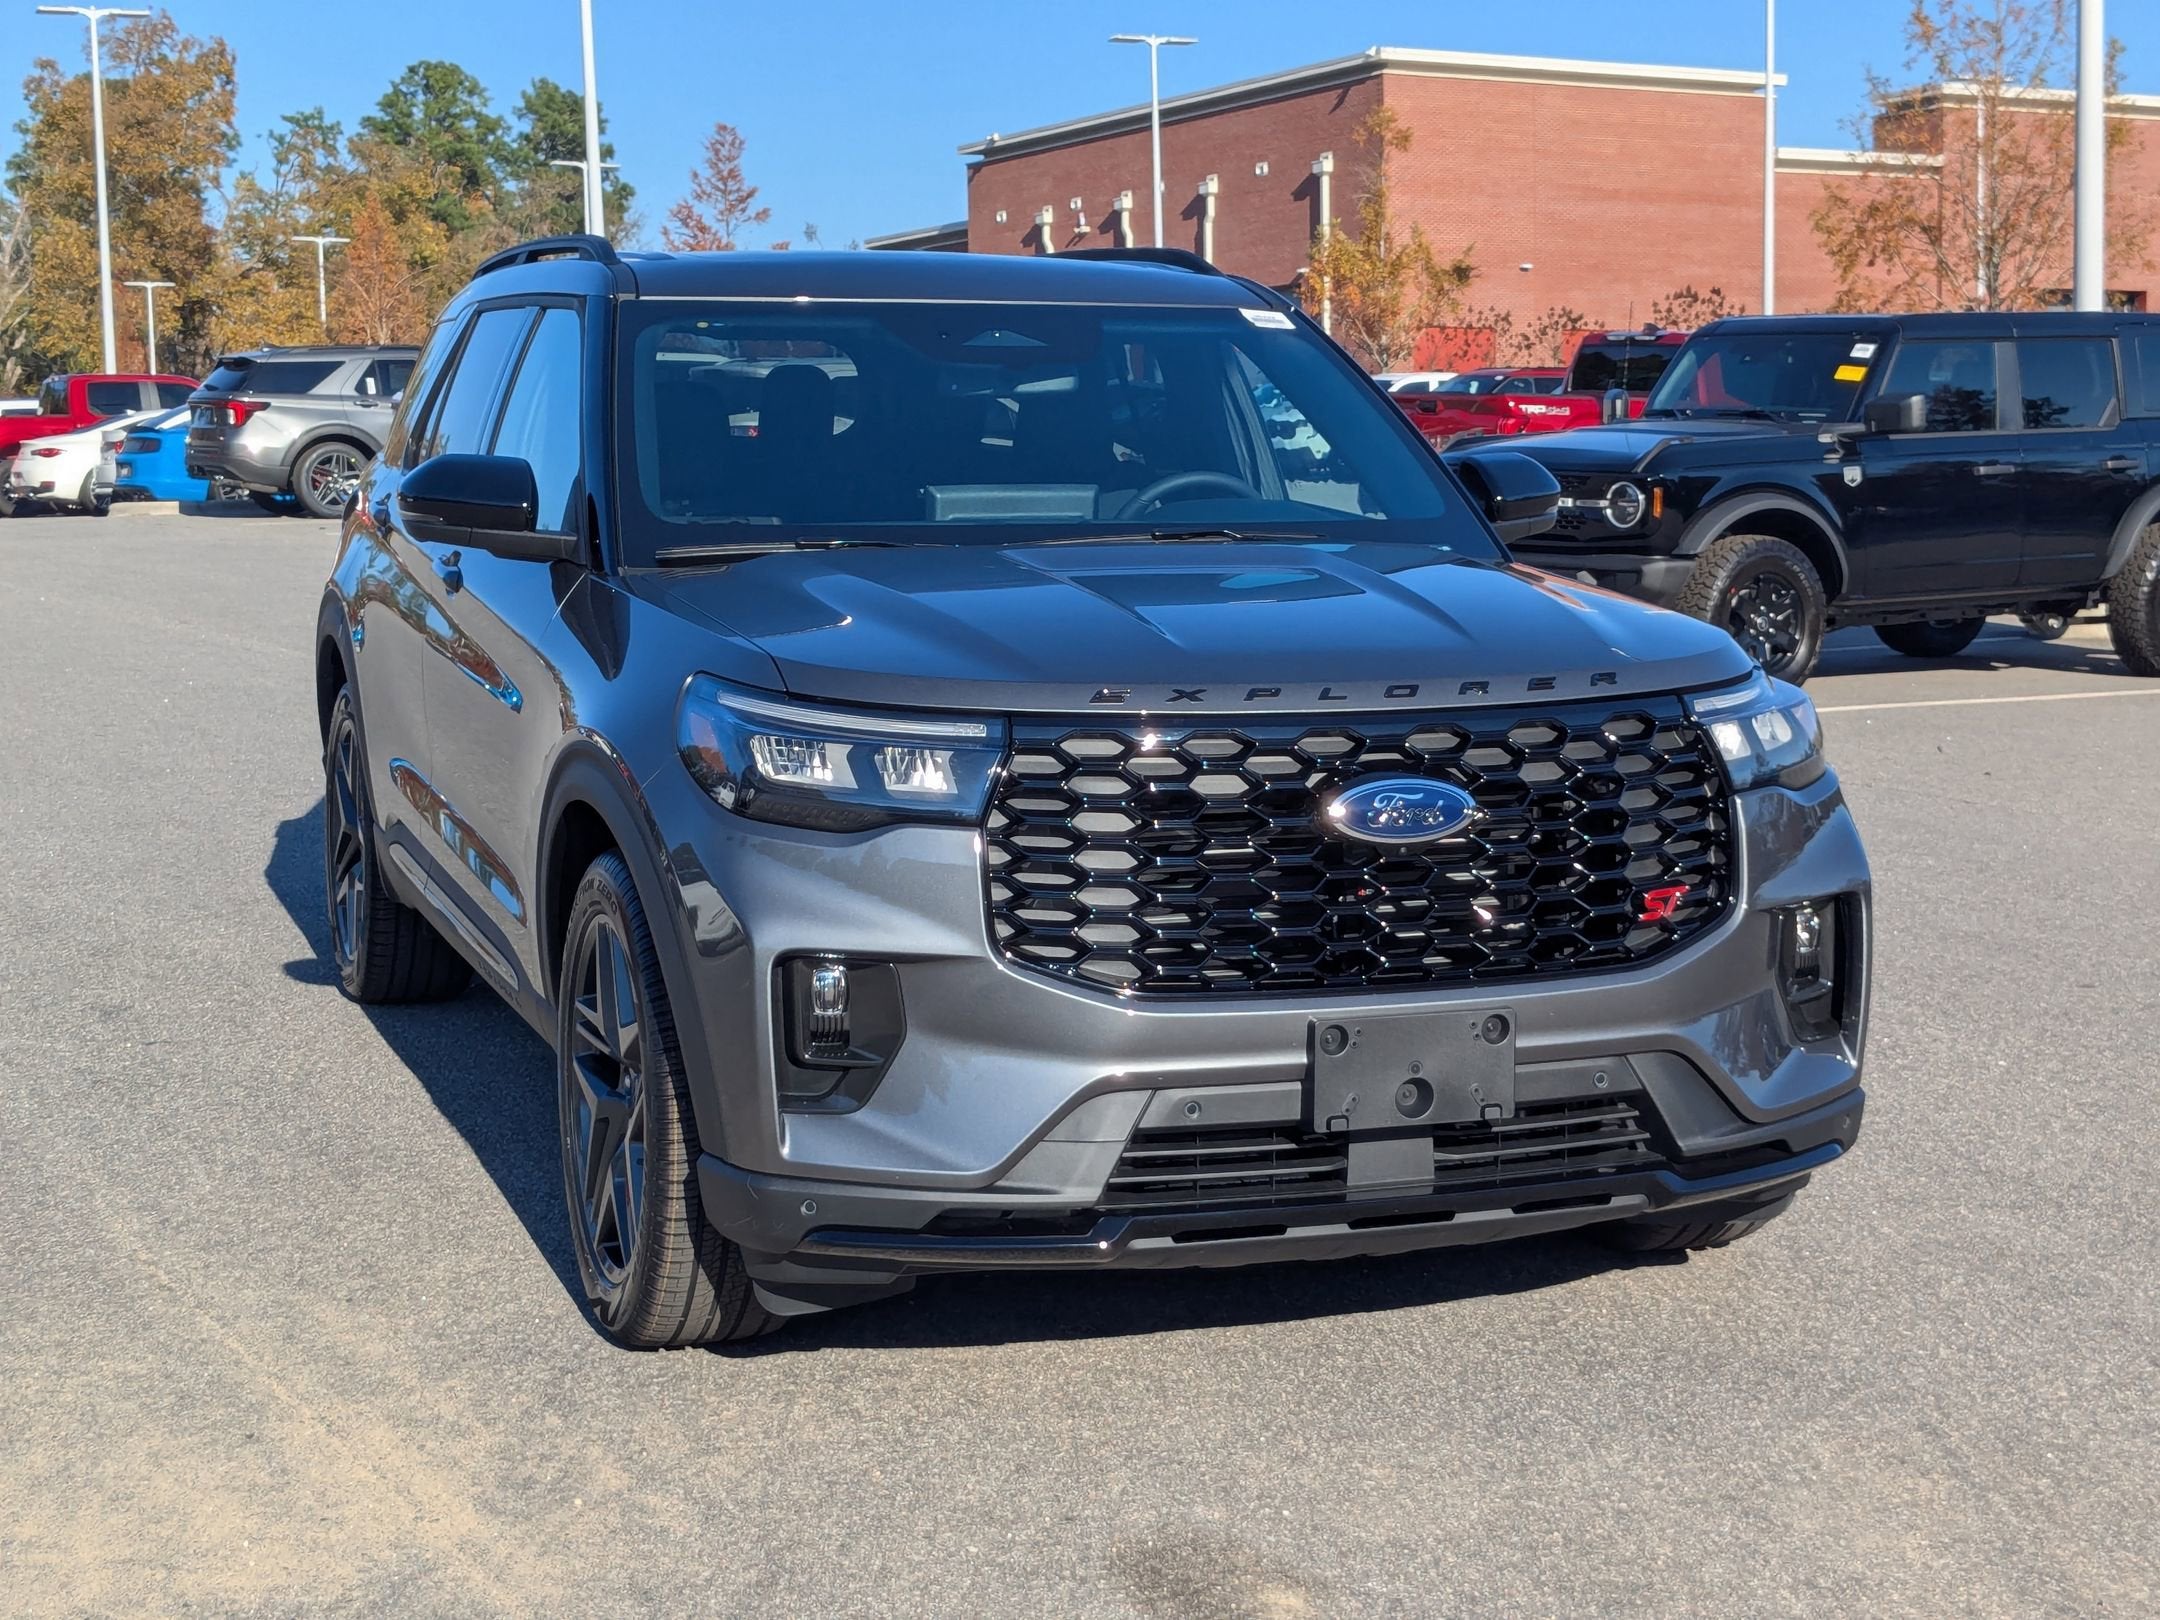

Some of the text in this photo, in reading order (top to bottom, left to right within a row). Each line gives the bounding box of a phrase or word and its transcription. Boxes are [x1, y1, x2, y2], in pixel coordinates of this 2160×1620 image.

[1089, 671, 1618, 704] EXPLORER
[1367, 792, 1444, 828] Ford
[1638, 884, 1690, 921] ST
